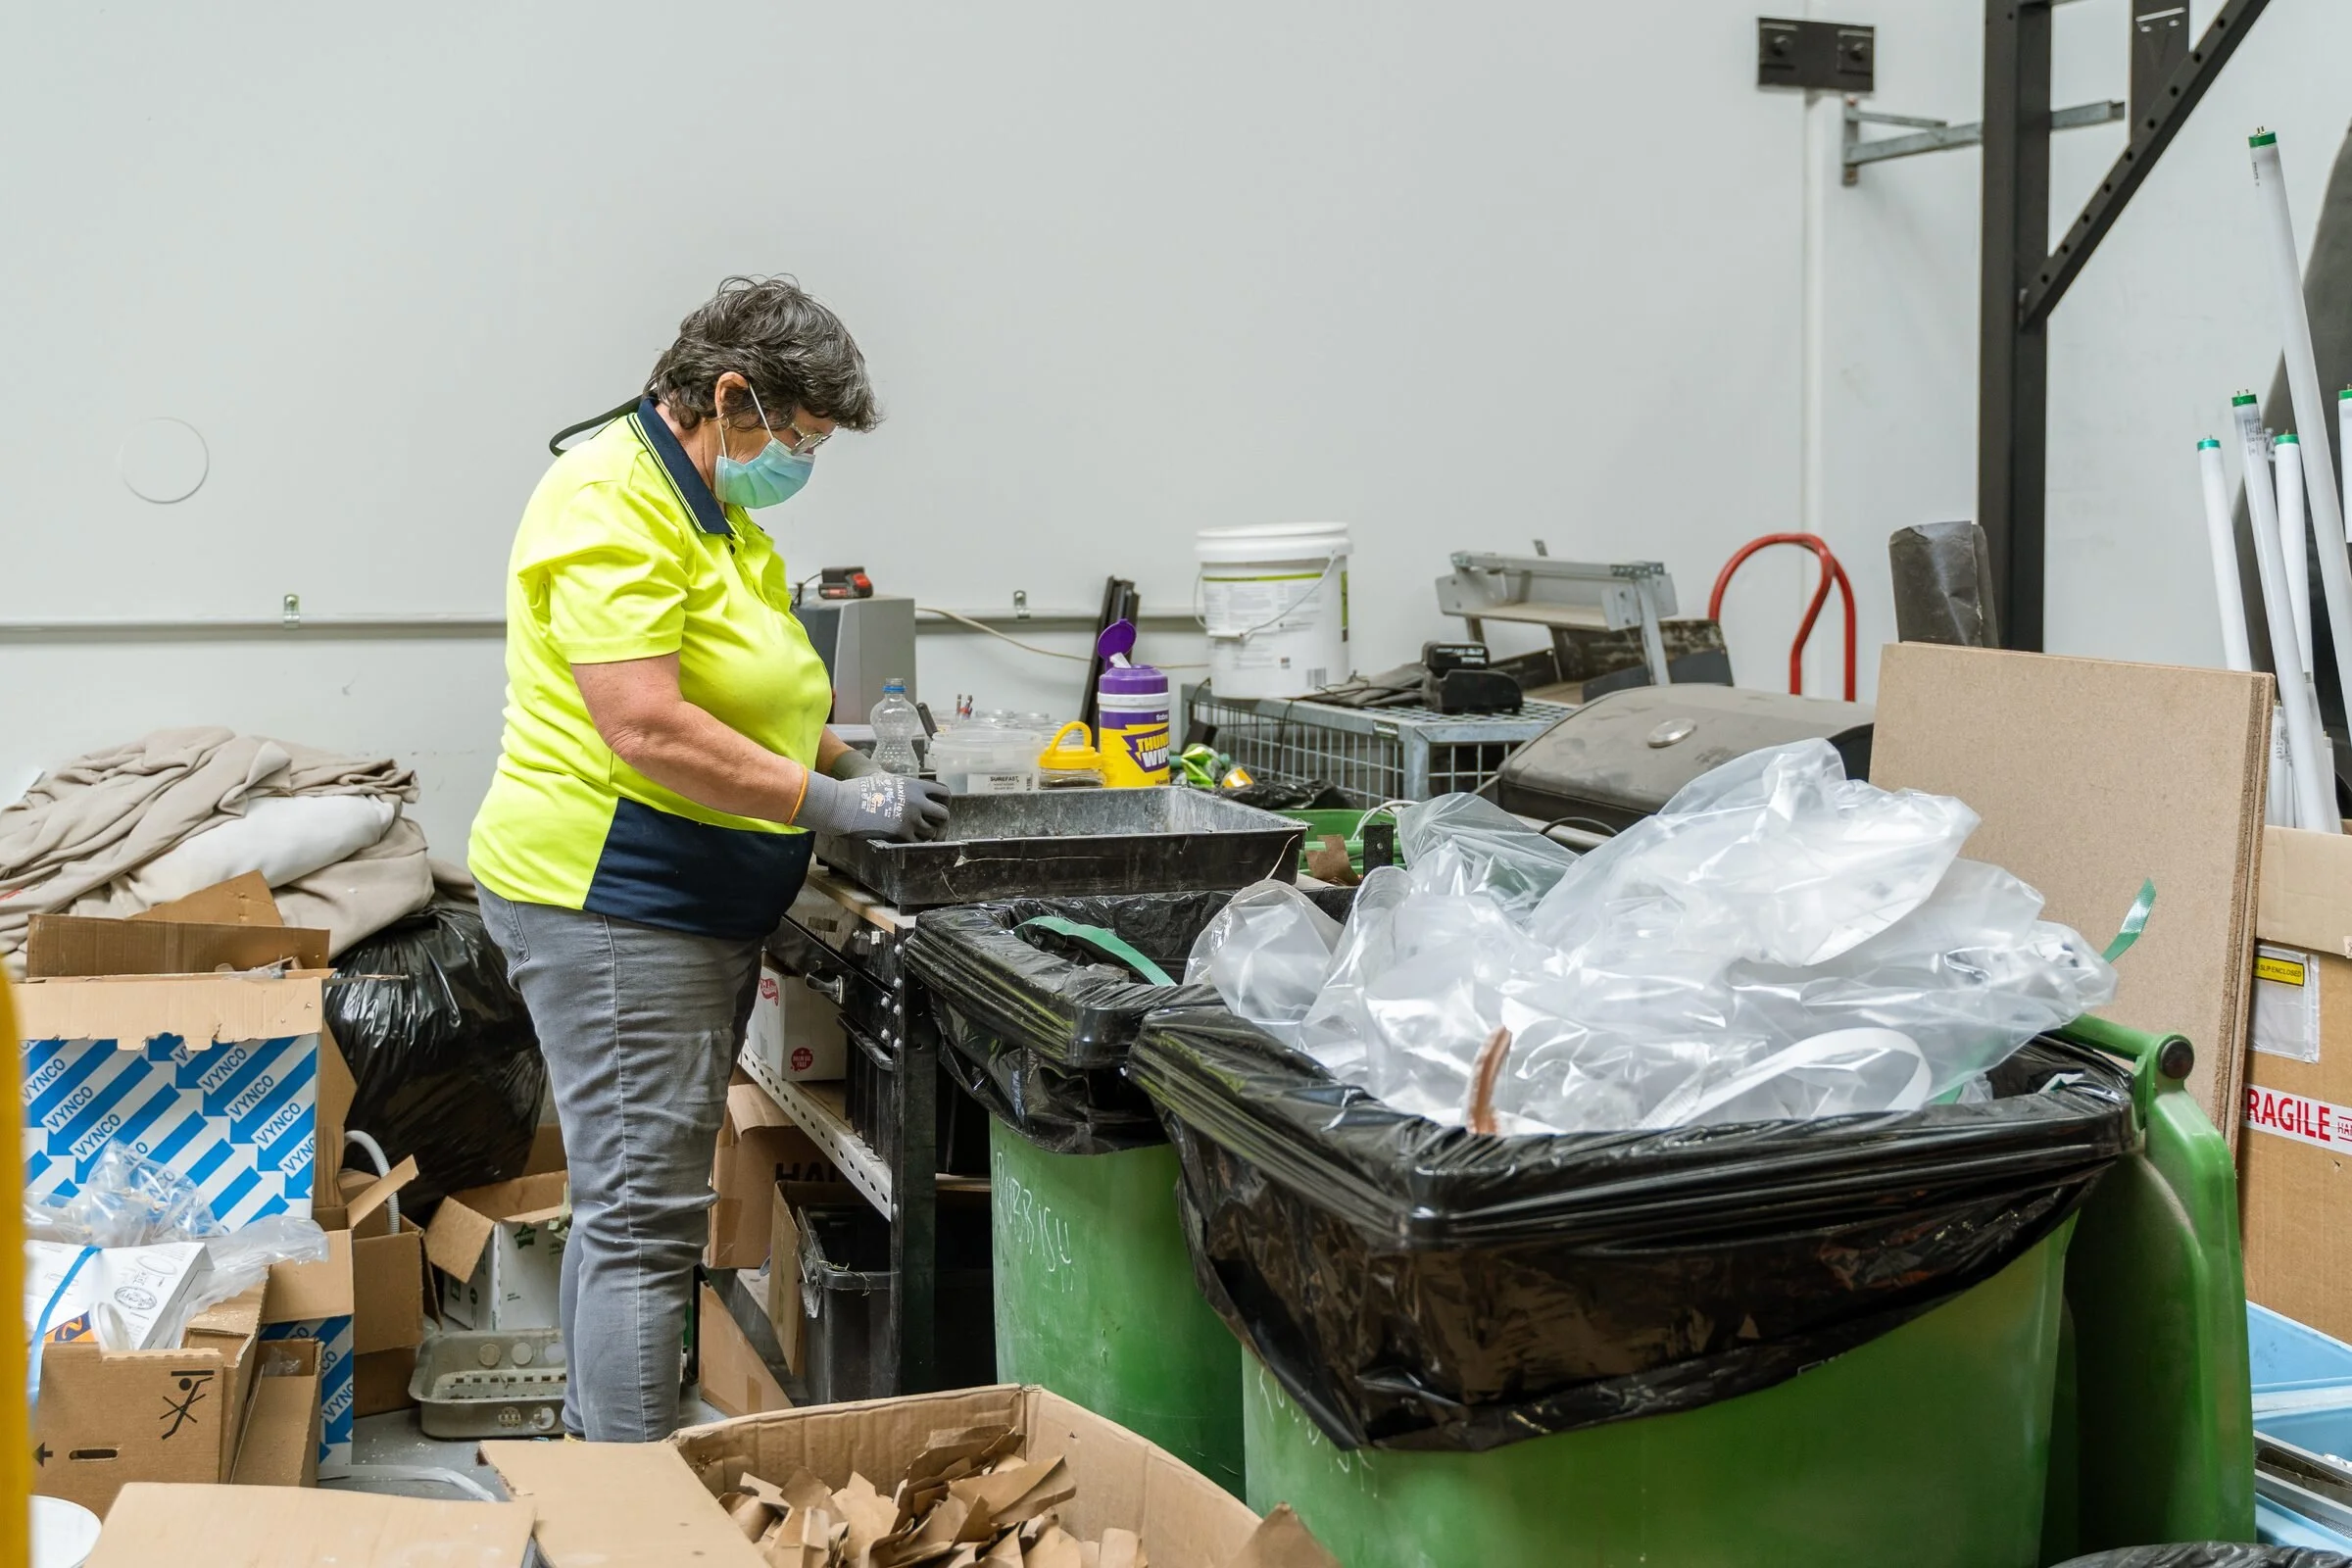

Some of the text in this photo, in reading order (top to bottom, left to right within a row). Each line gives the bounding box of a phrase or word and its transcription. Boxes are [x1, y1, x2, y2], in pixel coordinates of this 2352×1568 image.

[2272, 966, 2302, 978] ENCLOSED
[22, 1057, 67, 1102] VYNCO
[202, 1047, 247, 1091] VYNCO
[46, 1086, 93, 1128] VYNCO
[230, 1074, 275, 1118] VYNCO
[74, 1113, 122, 1156] VYNCO
[256, 1102, 302, 1146] VYNCO
